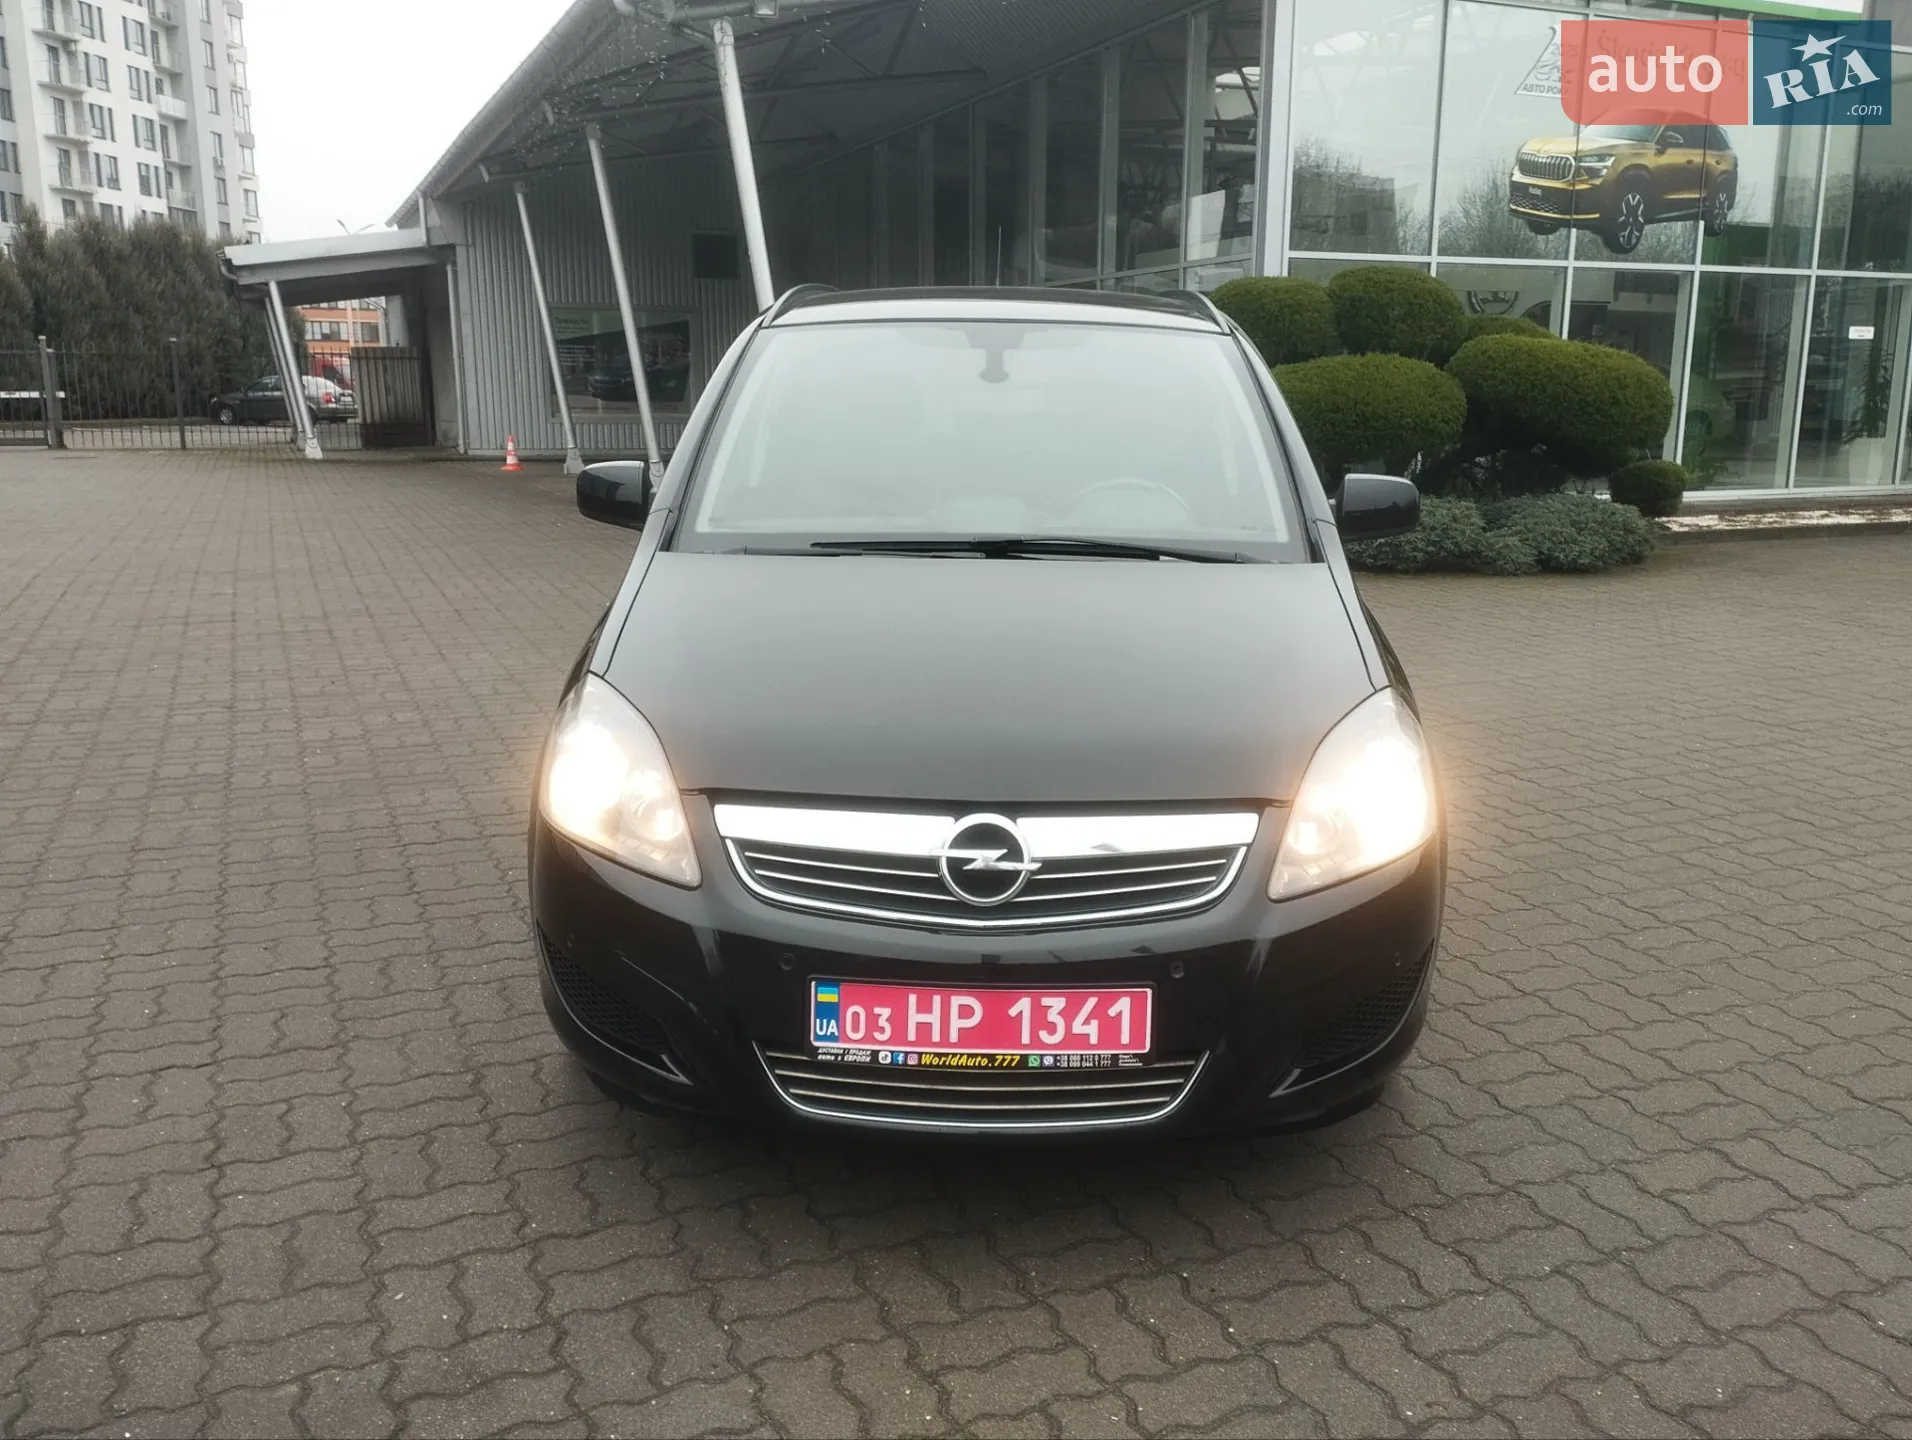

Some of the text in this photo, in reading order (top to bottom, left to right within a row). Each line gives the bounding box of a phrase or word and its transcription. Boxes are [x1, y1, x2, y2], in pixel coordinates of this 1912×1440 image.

[816, 994, 1131, 1045] UA 03 HP 1341
[921, 1053, 1021, 1068] WorldAuto.777
